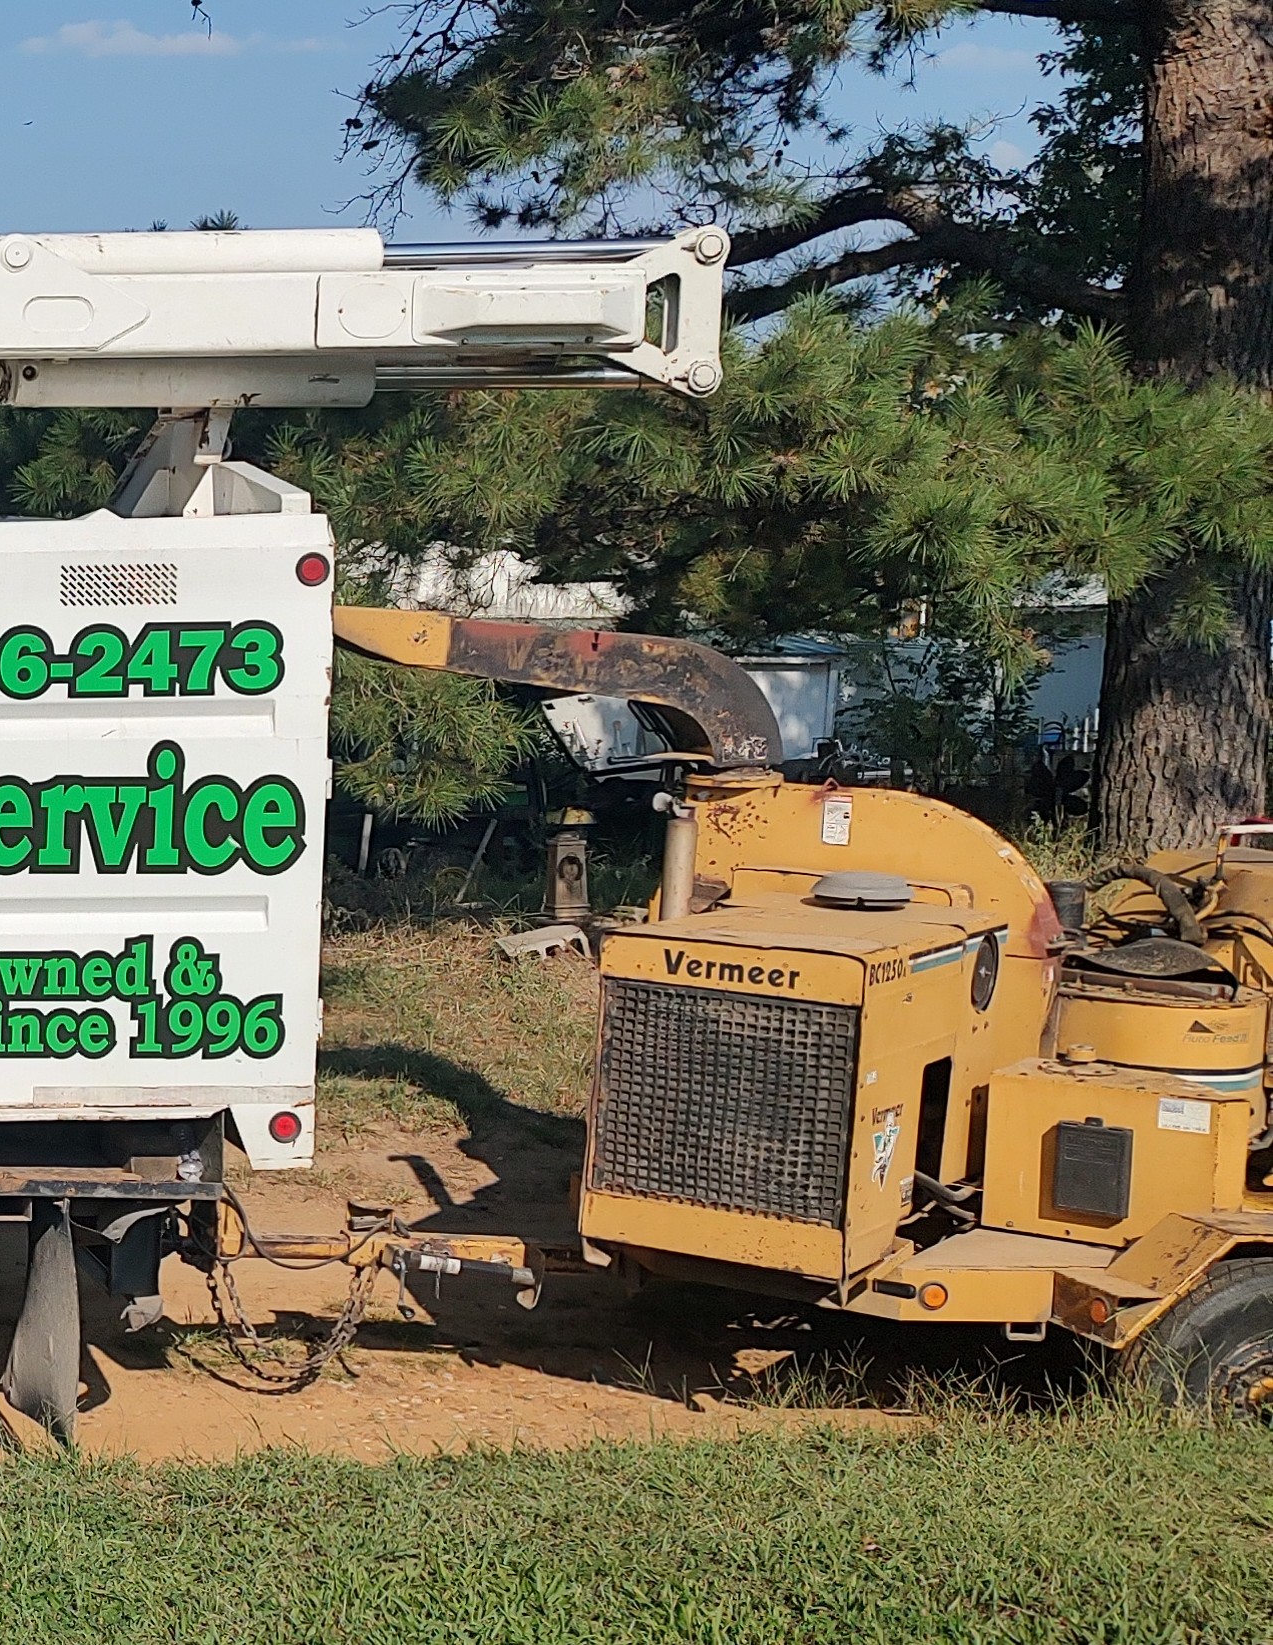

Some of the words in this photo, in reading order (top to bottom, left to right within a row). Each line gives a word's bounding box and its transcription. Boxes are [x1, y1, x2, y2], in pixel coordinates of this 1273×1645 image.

[167, 939, 220, 1000] &
[663, 948, 801, 990] Vermeer
[134, 996, 283, 1057] 1996
